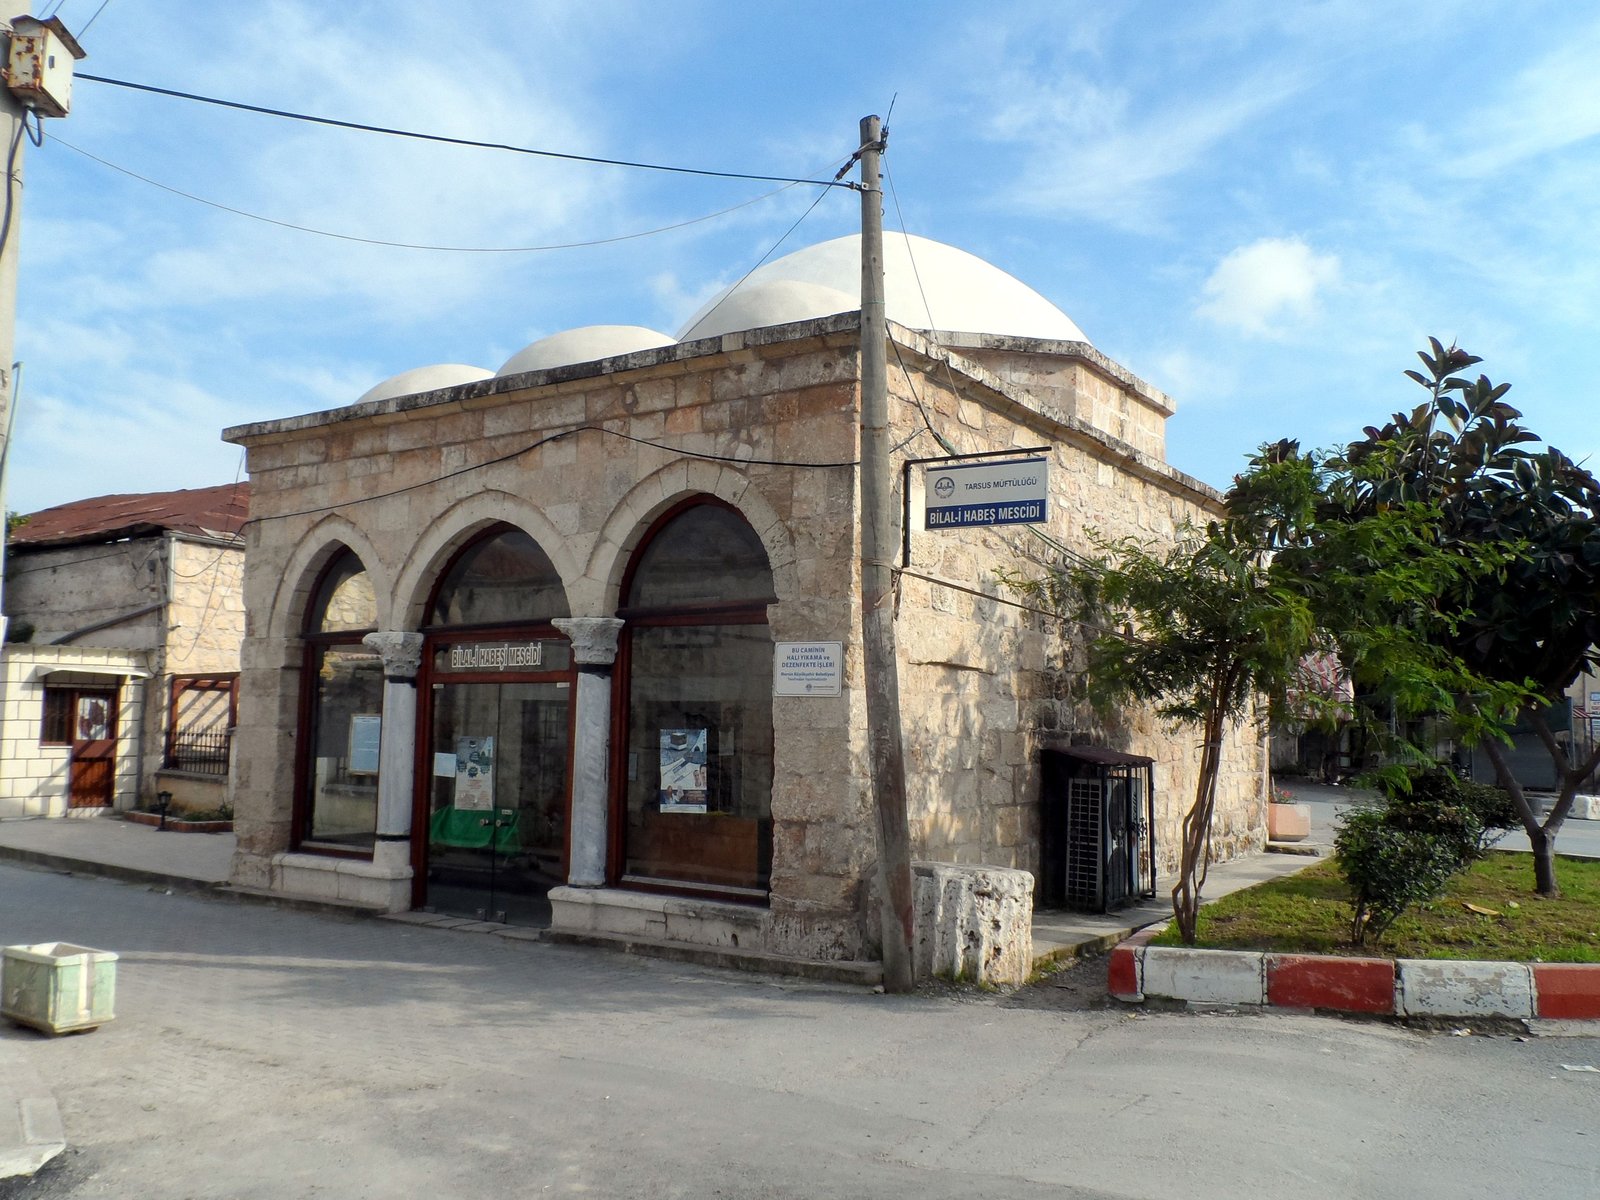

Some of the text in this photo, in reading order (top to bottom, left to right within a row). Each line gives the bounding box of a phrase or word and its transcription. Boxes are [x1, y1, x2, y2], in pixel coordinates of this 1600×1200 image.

[965, 476, 1037, 490] TARSUS MÜFTÜLÜĞÜ
[930, 502, 1040, 524] BİLAL-İ HABEŞ MESCİDİ
[452, 642, 541, 671] BİLAL-İ HABEŞİ MESCİDİ
[816, 661, 835, 669] İŞLERİ
